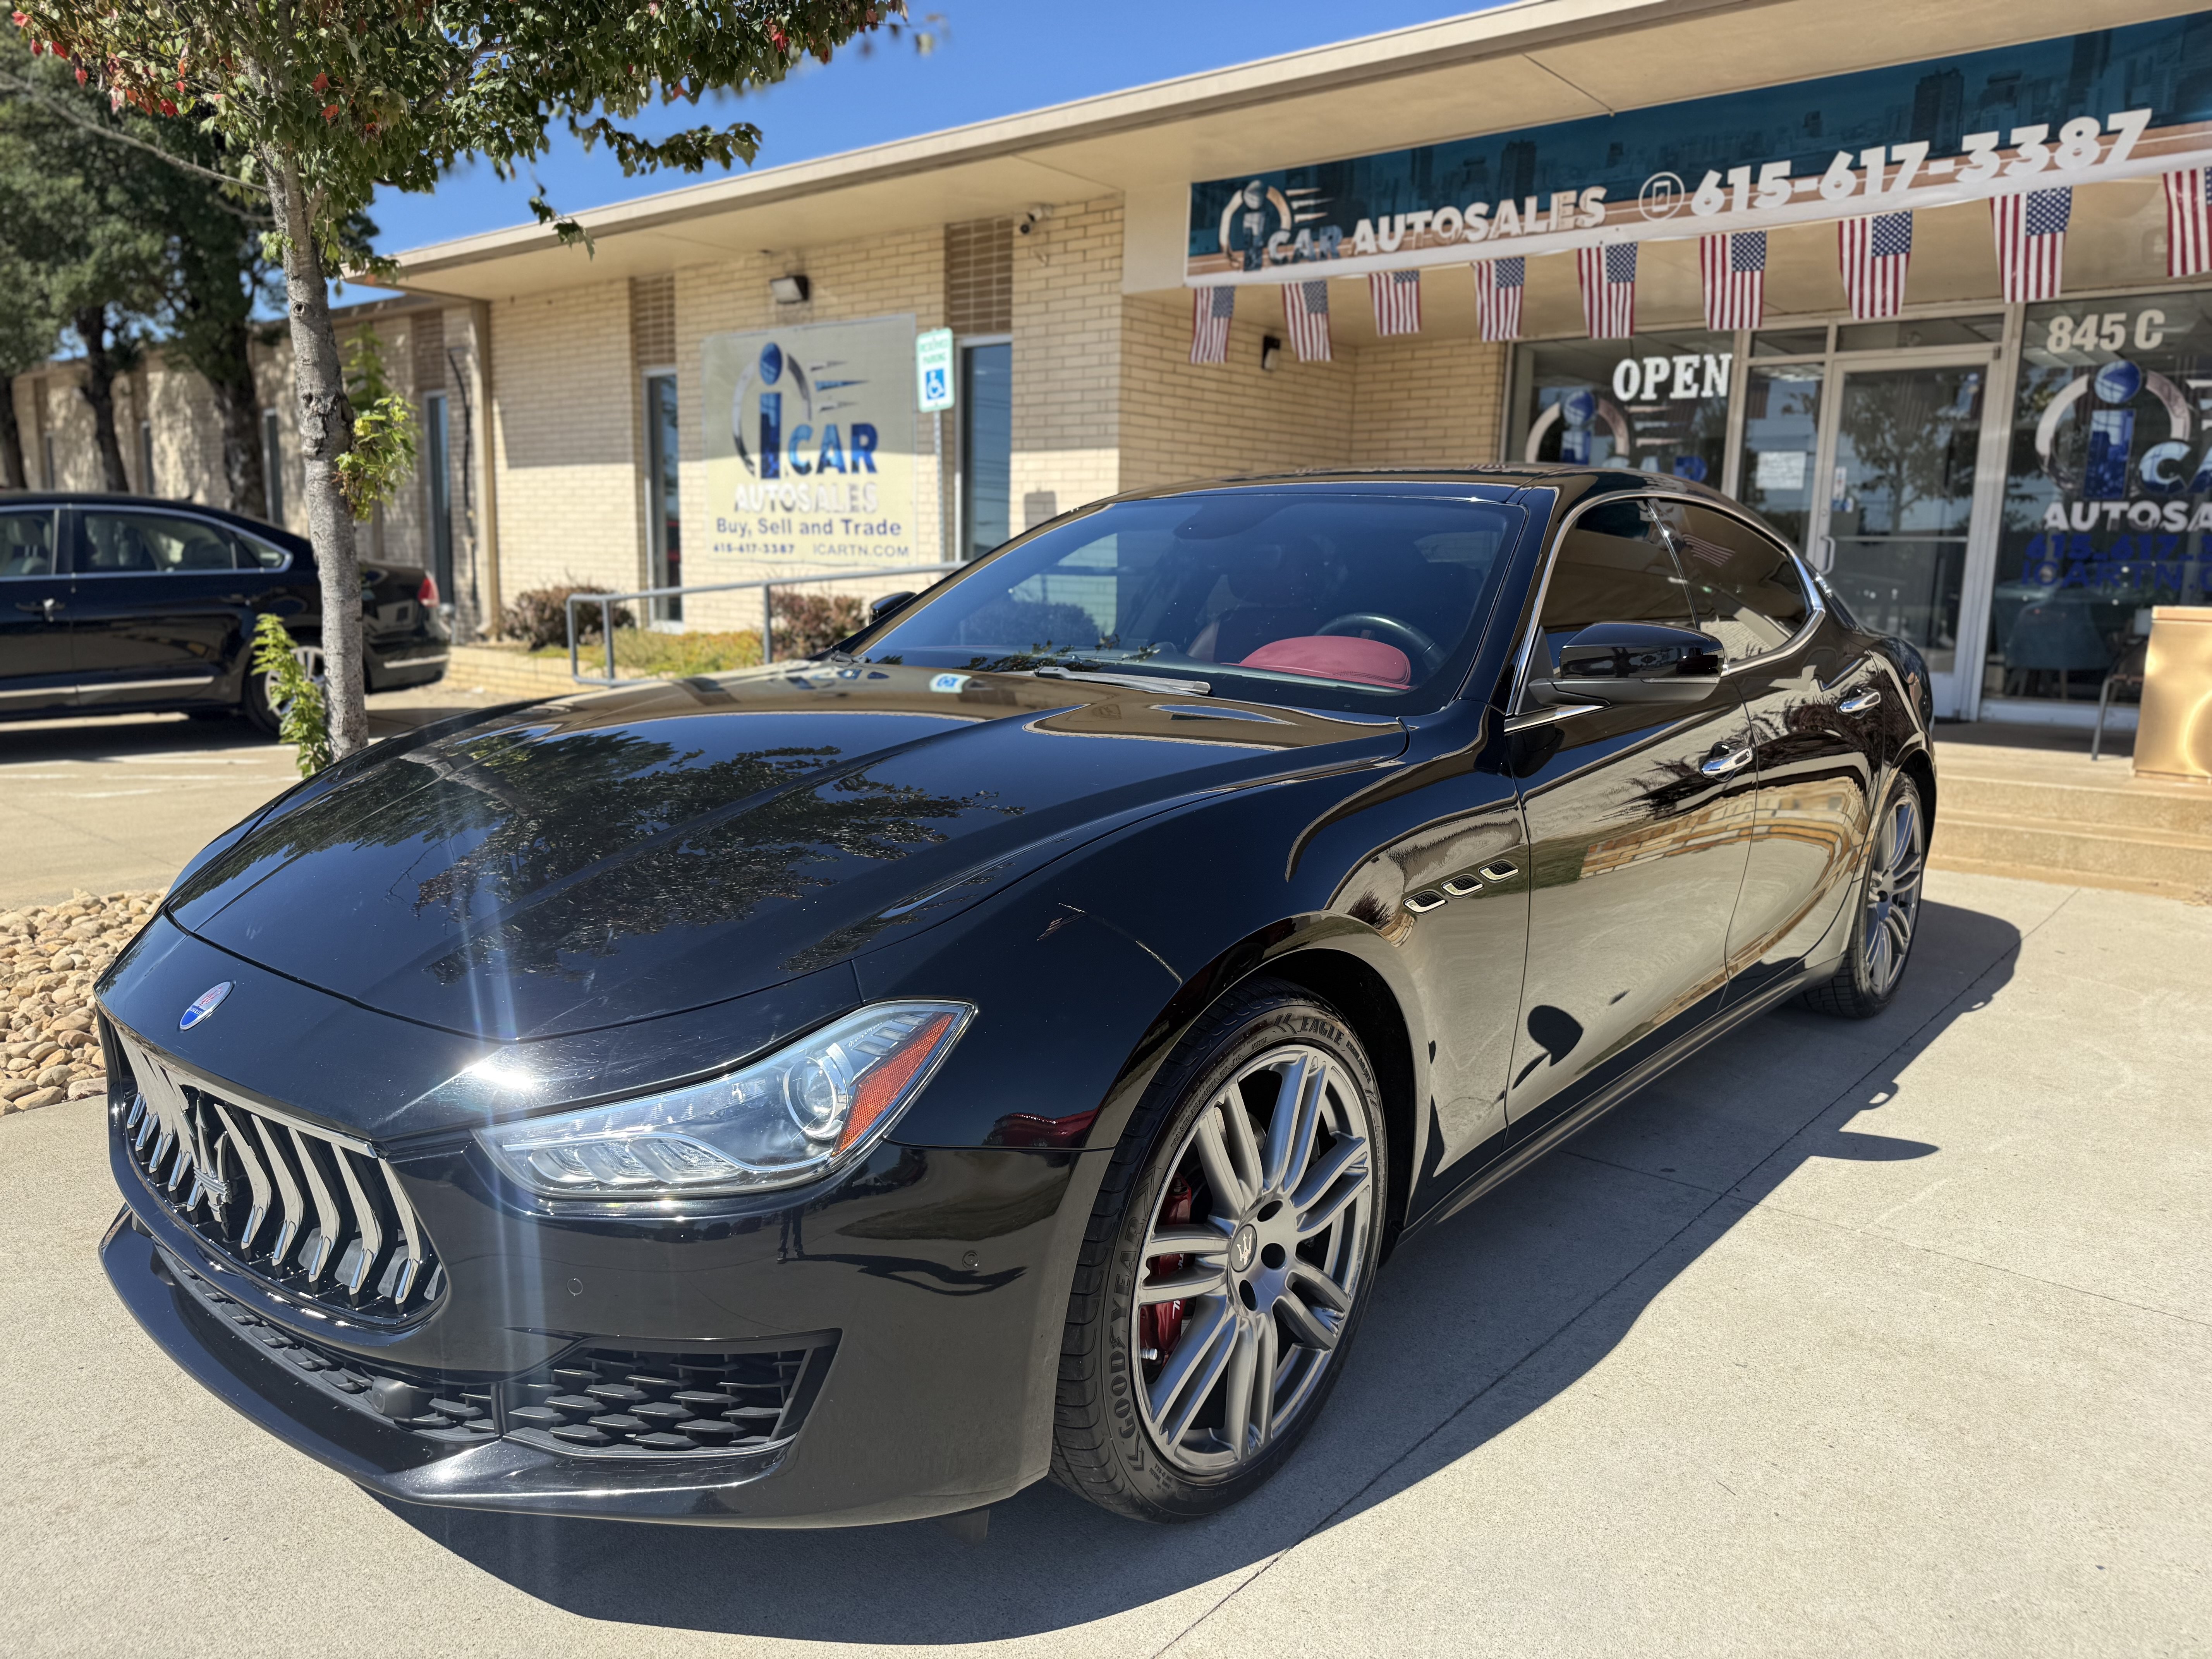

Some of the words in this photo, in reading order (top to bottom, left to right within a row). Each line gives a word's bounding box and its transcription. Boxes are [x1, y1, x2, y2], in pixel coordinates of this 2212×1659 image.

[1350, 186, 1607, 256] AUTOSALES
[1690, 108, 2152, 217] 615-617-3387
[2046, 313, 2126, 354] 845
[2133, 309, 2164, 350] C
[1612, 353, 1733, 401] OPEN
[735, 483, 878, 514] AUTOSALES
[716, 518, 752, 538] Buy,
[758, 517, 792, 534] Sell
[799, 519, 833, 535] and
[840, 519, 902, 536] Trade
[814, 544, 910, 557] ICARTN.COM
[1302, 1015, 1344, 1046] EAGLE
[1109, 1217, 1143, 1439] GOODYEAR
